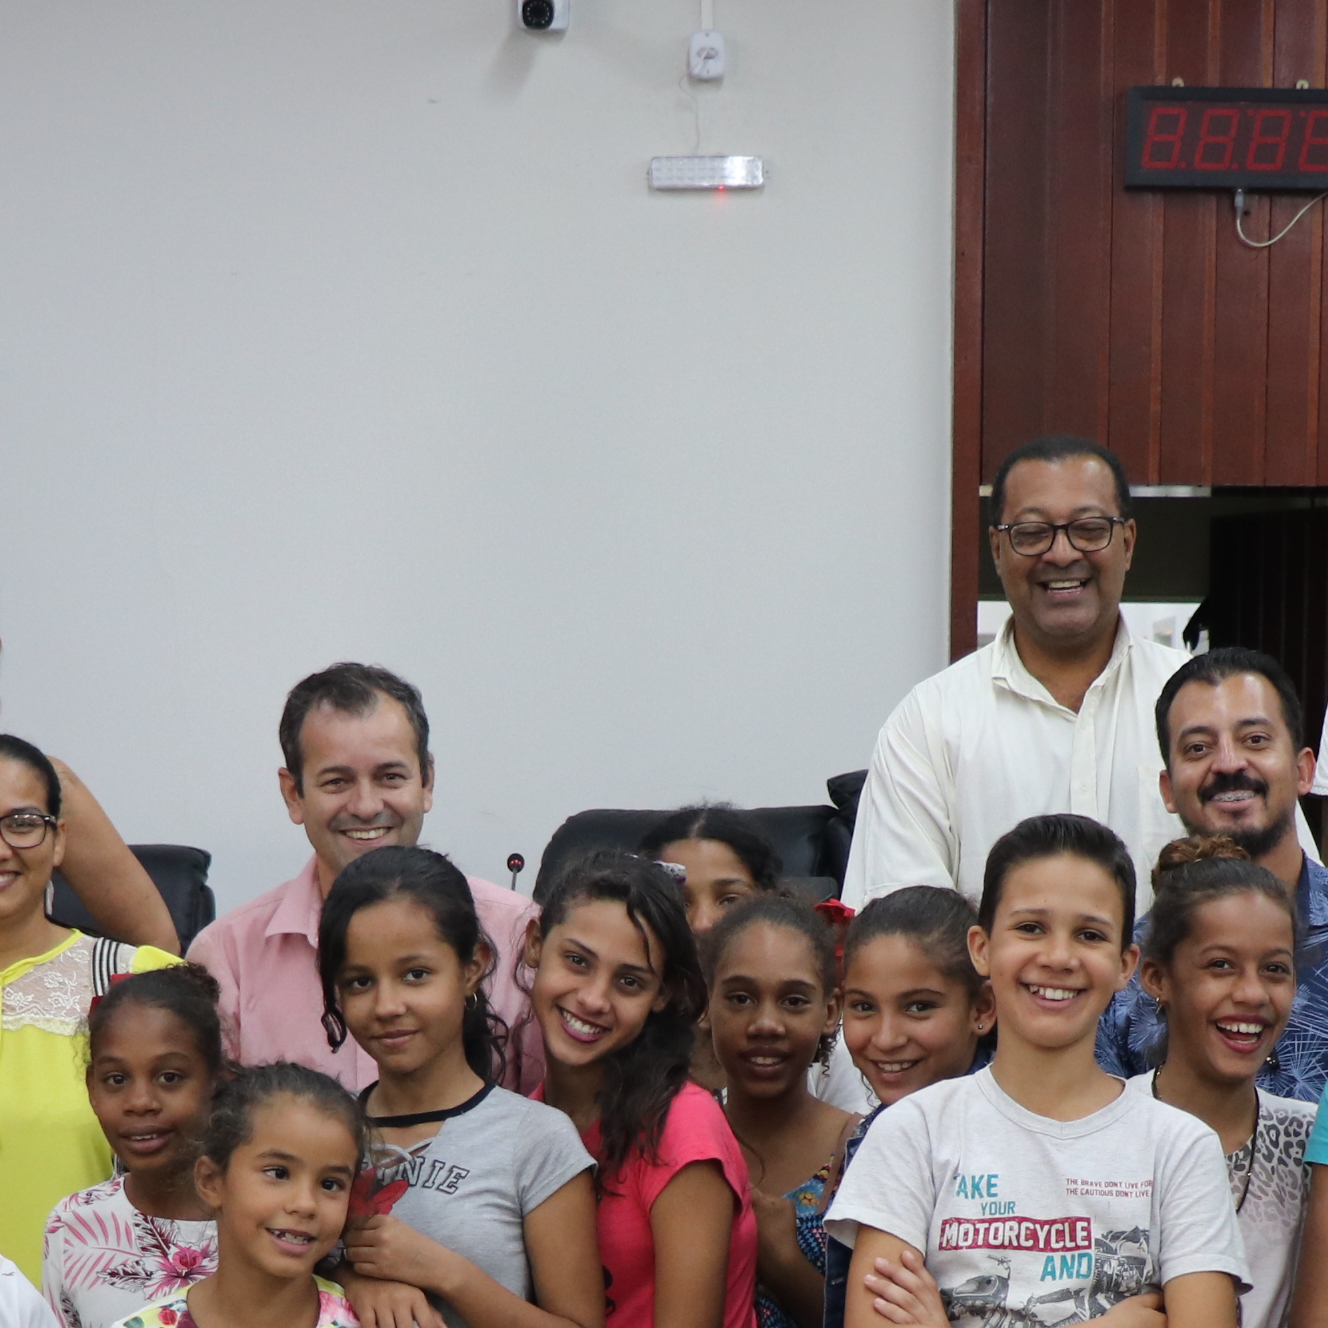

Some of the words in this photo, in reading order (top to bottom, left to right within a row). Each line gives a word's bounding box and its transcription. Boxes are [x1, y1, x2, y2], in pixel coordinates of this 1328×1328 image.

[953, 1173, 999, 1200] AKE
[1065, 1178, 1079, 1186] THE
[1080, 1179, 1103, 1188] BRAVE
[1065, 1187, 1079, 1196] THE
[1080, 1188, 1114, 1197] CAUTIOUS
[1135, 1189, 1150, 1198] LIVE
[980, 1200, 1017, 1217] YOUR
[941, 1219, 1091, 1250] MOTORCYCLE
[1039, 1251, 1094, 1283] AND
